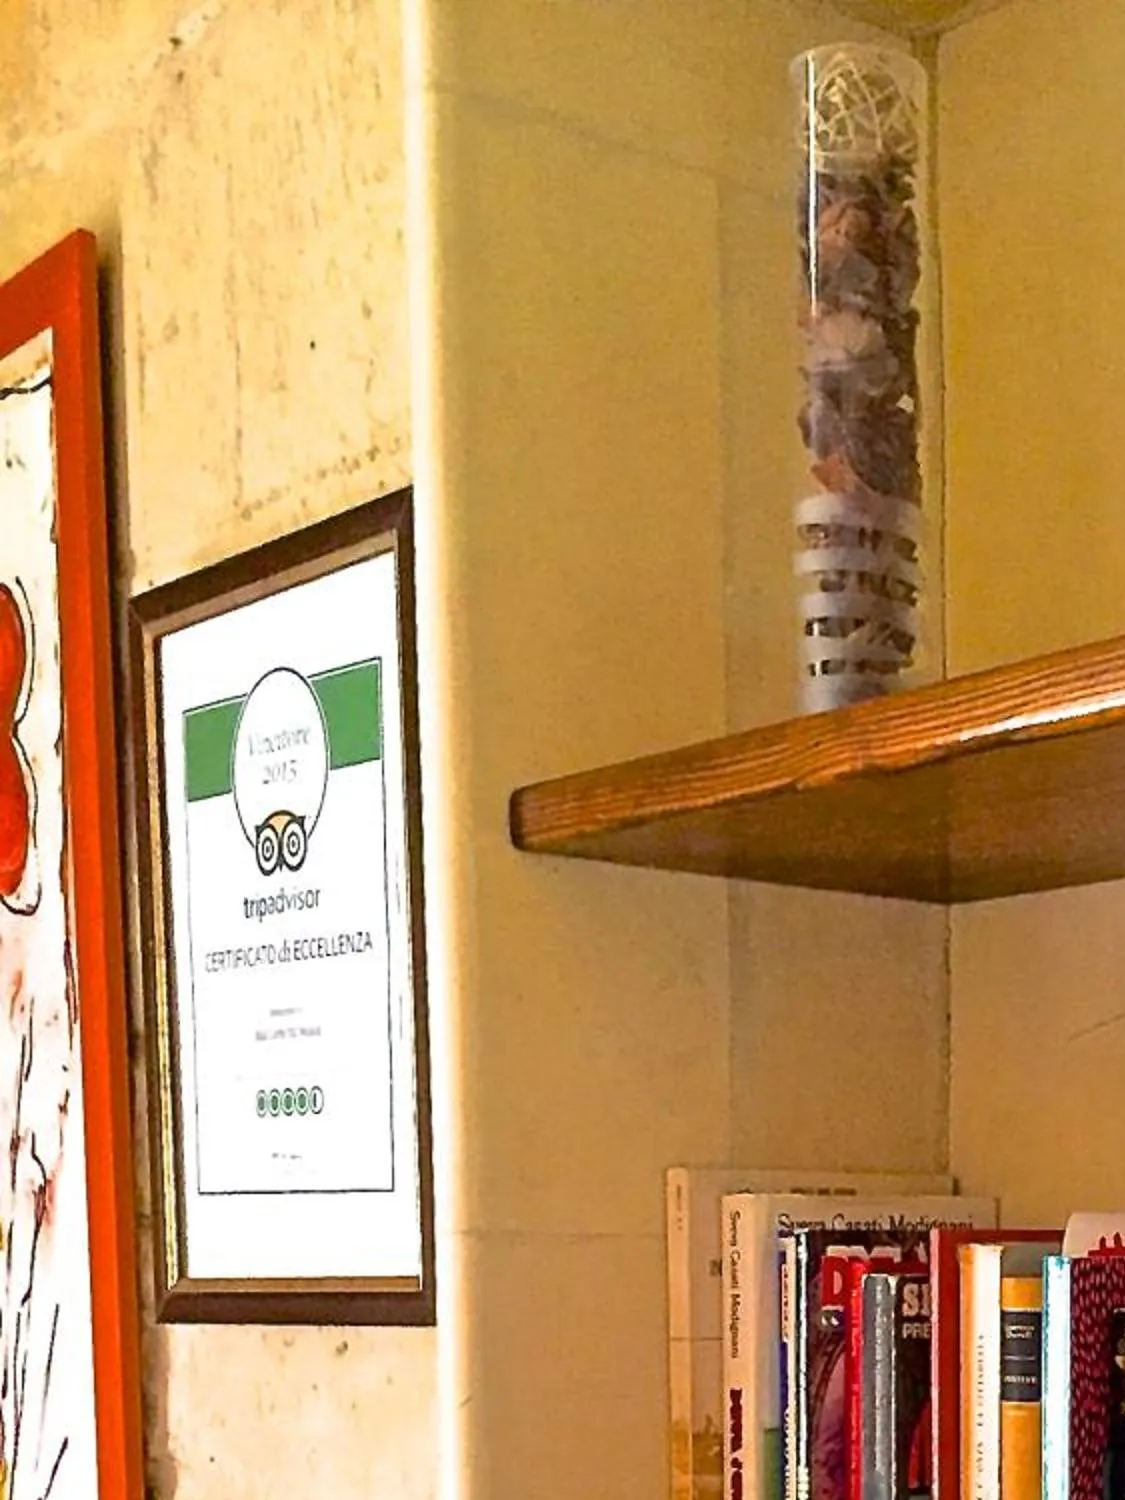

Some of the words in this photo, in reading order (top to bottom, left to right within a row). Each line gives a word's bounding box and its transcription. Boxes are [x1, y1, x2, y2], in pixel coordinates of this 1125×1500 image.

[243, 887, 321, 923] tripadvisor
[204, 943, 277, 973] CERTIFICATO
[278, 939, 291, 963] di
[293, 931, 373, 961] ECCELLENZA
